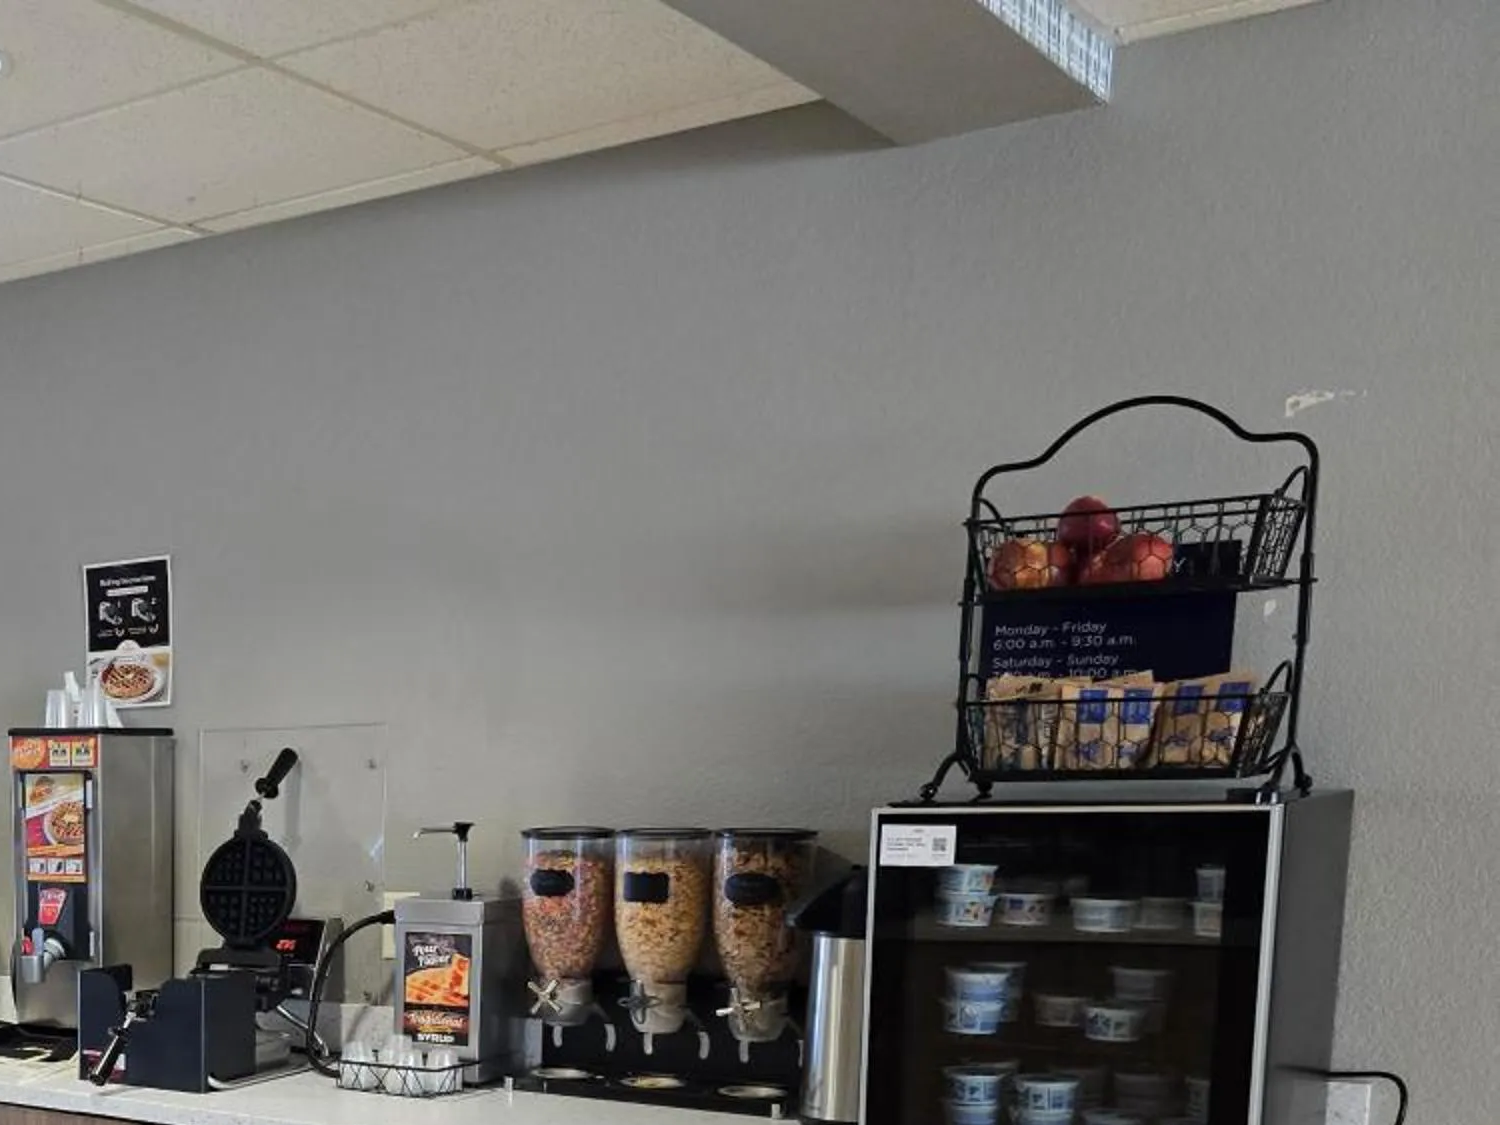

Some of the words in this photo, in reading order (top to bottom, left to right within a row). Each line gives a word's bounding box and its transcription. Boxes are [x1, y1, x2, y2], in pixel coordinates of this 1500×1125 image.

[995, 624, 1048, 636] Monday
[1062, 620, 1107, 634] Friday
[992, 639, 1026, 651] 6:00
[1071, 634, 1103, 648] 9:30
[992, 656, 1052, 669] Saturday
[1066, 653, 1119, 667] Sunday
